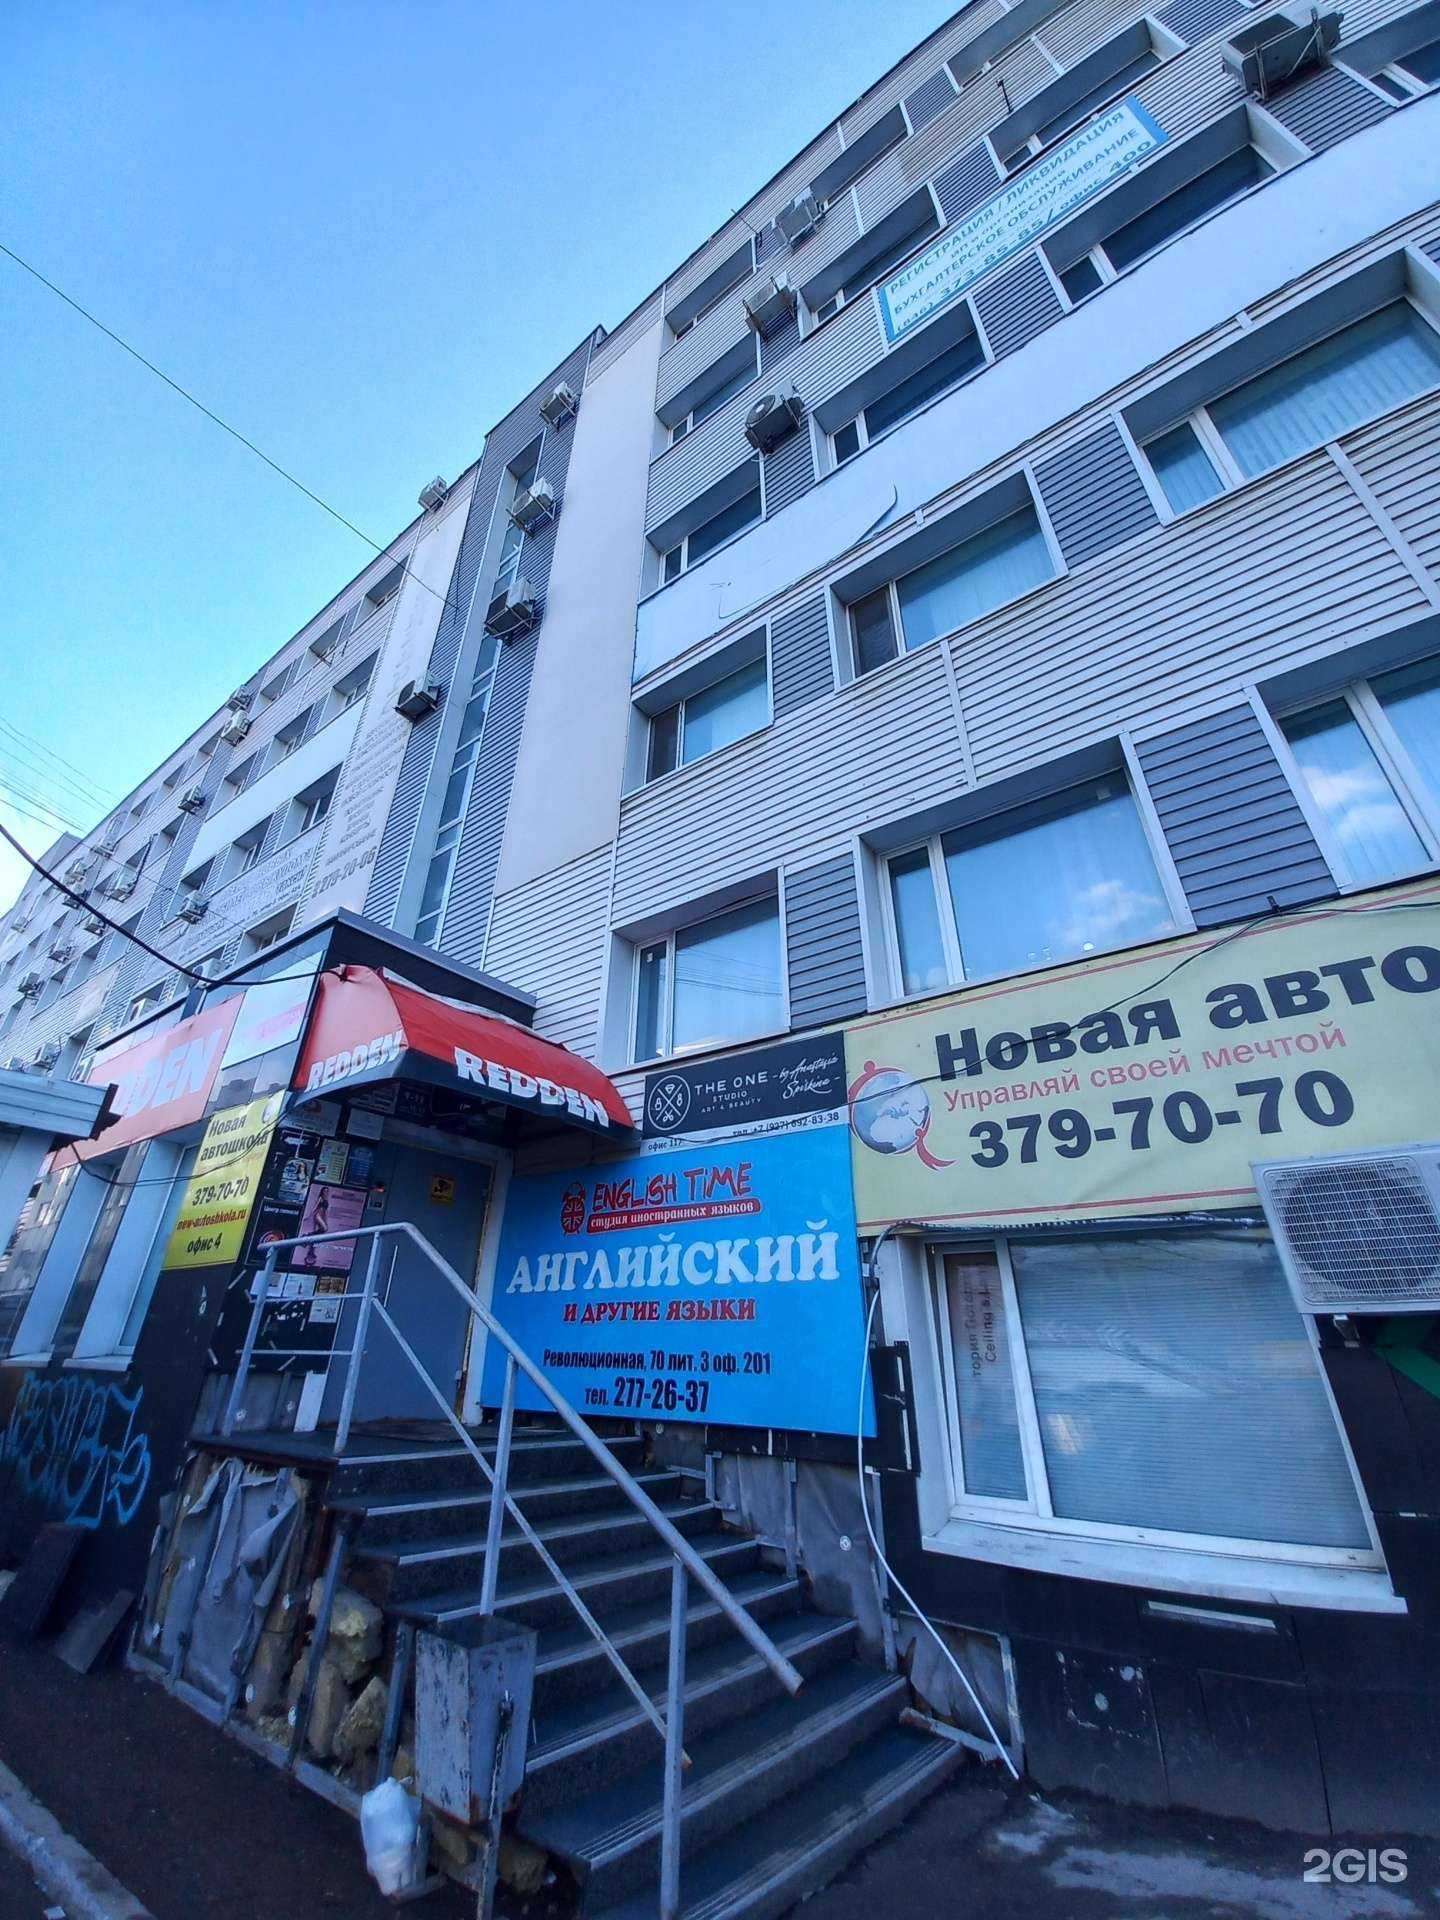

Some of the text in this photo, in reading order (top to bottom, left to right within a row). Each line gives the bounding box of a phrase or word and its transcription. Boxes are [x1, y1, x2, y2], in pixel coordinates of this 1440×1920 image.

[1109, 140, 1152, 173] 400
[889, 208, 994, 294] РЕГИСТРАЦИЯ
[1006, 111, 1124, 203] ЛИКВИДАЦИЯ
[894, 127, 1139, 315] БУХГАЛТЕРСКОЕ ОБСЛУЖИВАНИЕ
[935, 998, 1182, 1082] Новая
[304, 1029, 405, 1093] REDDEN
[944, 1020, 1347, 1112] Управляй своей мечтой
[454, 1046, 610, 1128] REDDEN
[694, 1070, 769, 1097] THE ONE
[713, 1090, 748, 1103] STUDIO
[728, 1097, 761, 1110] BEAUTY
[969, 1069, 1354, 1169] 379-70-70
[207, 1114, 248, 1138] Новая
[200, 1129, 269, 1162] автошкола
[191, 1176, 250, 1207] 379-70-70
[591, 1201, 754, 1230] студия иностранных языков
[187, 1232, 223, 1256] офис 4
[505, 1218, 840, 1295] АНГЛИЙСКИЙ
[563, 1298, 756, 1325] И ДРУГИЕ ЯЗЫКИ
[543, 1348, 648, 1372] Революционная,
[650, 1350, 665, 1371] 70
[667, 1352, 698, 1372] лит.
[712, 1352, 740, 1376] оф.
[743, 1351, 772, 1376] 201
[585, 1376, 710, 1413] тел. 277-26-37
